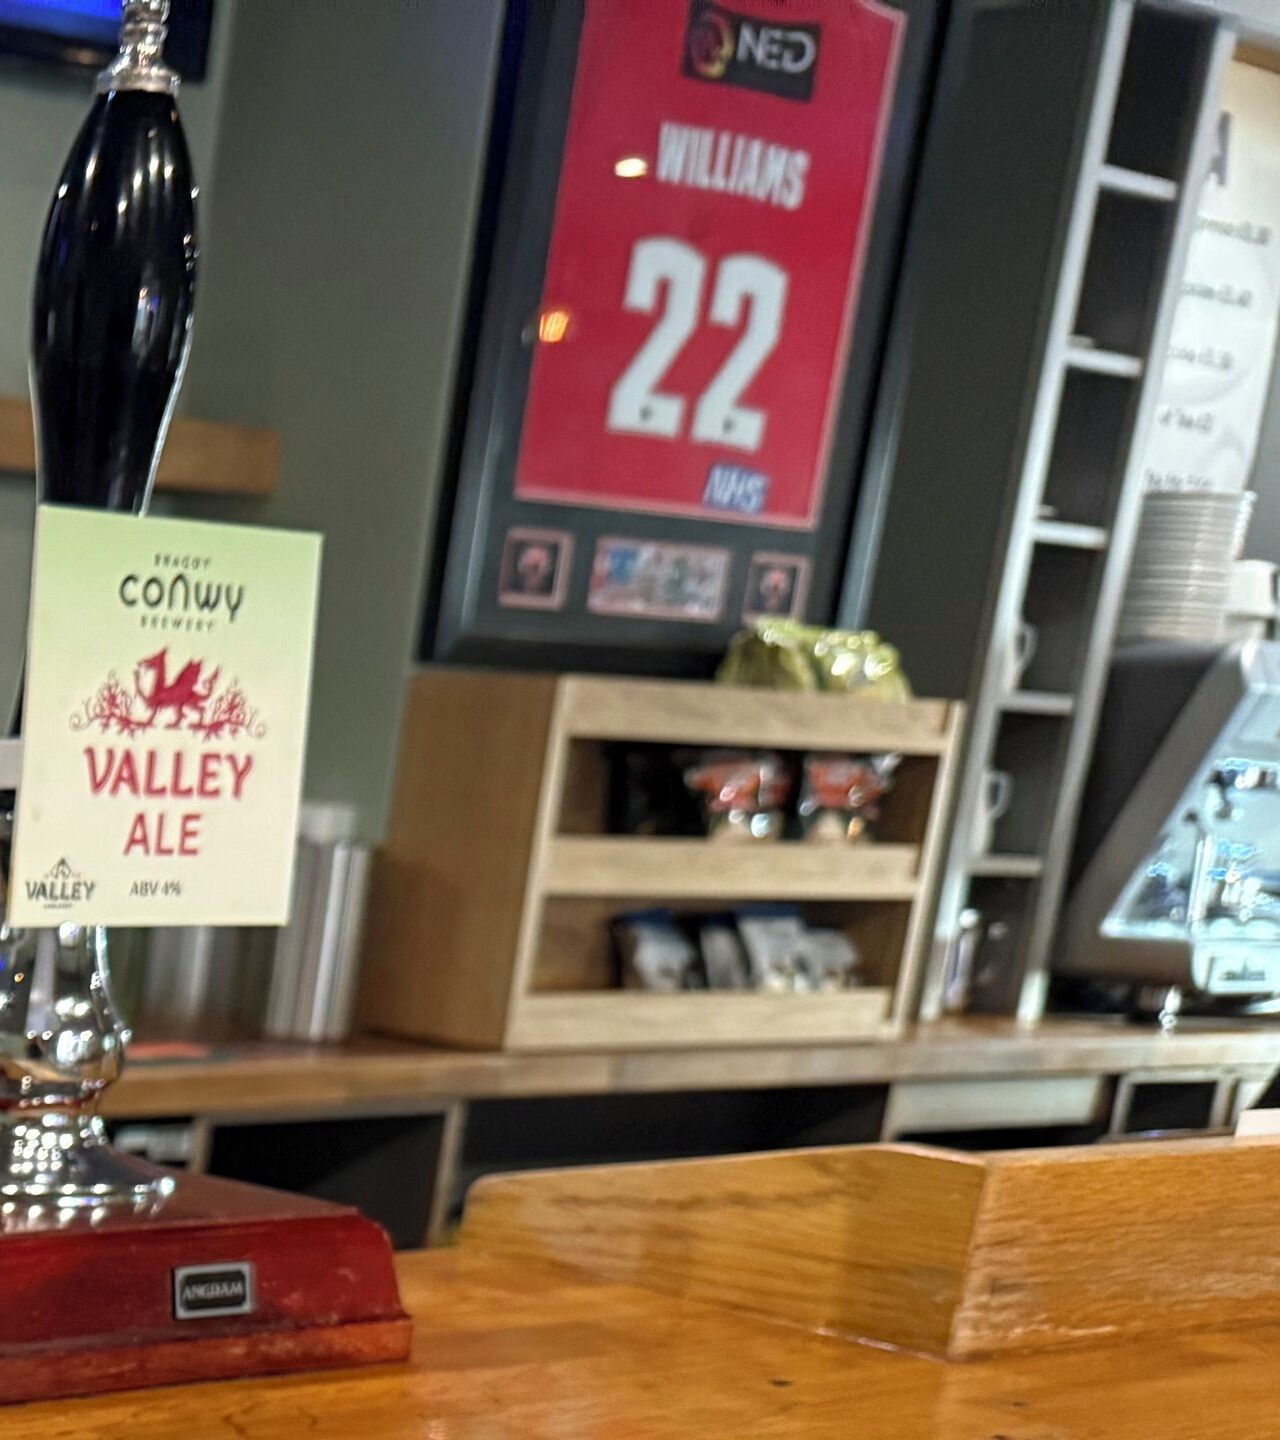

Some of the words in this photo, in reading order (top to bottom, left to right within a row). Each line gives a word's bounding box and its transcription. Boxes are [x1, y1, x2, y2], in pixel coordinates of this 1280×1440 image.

[657, 121, 809, 211] WILLIAMS
[606, 235, 788, 453] 22
[707, 466, 768, 510] NHS
[119, 573, 245, 623] CONWY
[84, 746, 254, 800] VALLEY
[123, 812, 202, 857] ALE
[25, 881, 96, 900] VALLEY
[130, 881, 159, 897] ABV
[182, 1281, 244, 1300] ANGRAM
